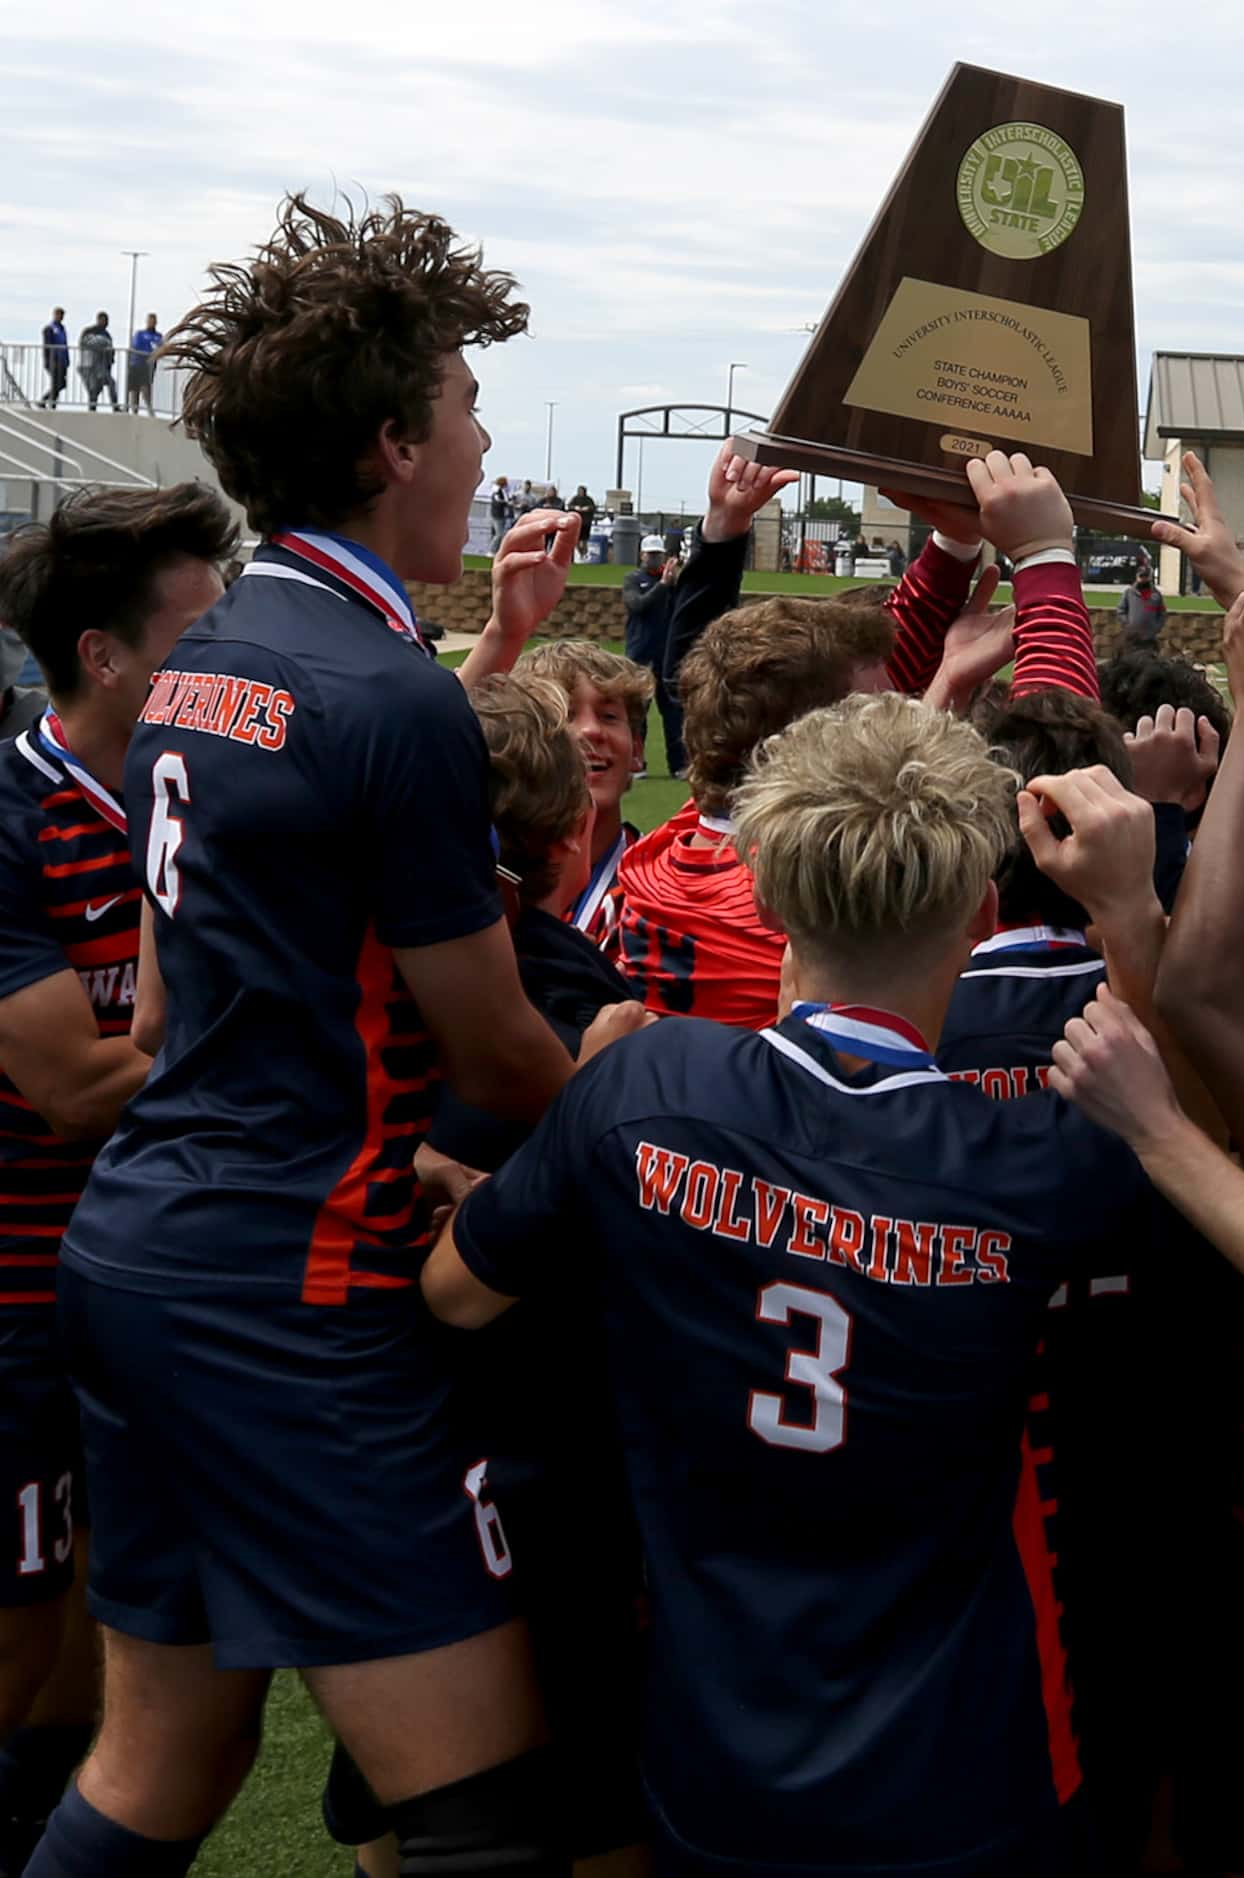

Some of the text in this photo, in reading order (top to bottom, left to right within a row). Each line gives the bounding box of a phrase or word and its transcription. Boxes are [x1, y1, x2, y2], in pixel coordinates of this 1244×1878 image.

[990, 208, 1041, 233] STATE
[892, 309, 1068, 394] UNIVERSITY INTERSCHOLASTIC LEAGUE
[934, 360, 1028, 389] STATE CHAMPION
[936, 376, 1018, 404] BOYS' SOCCER
[916, 388, 1032, 423] CONFERENCE AAAAA
[951, 438, 980, 453] 2021
[138, 669, 295, 751] OLVERINES
[146, 750, 191, 920] 6
[636, 1141, 1012, 1287] WOLVERINES
[746, 1279, 853, 1453] 3
[17, 1470, 74, 1575] 13
[464, 1458, 513, 1580] 6
